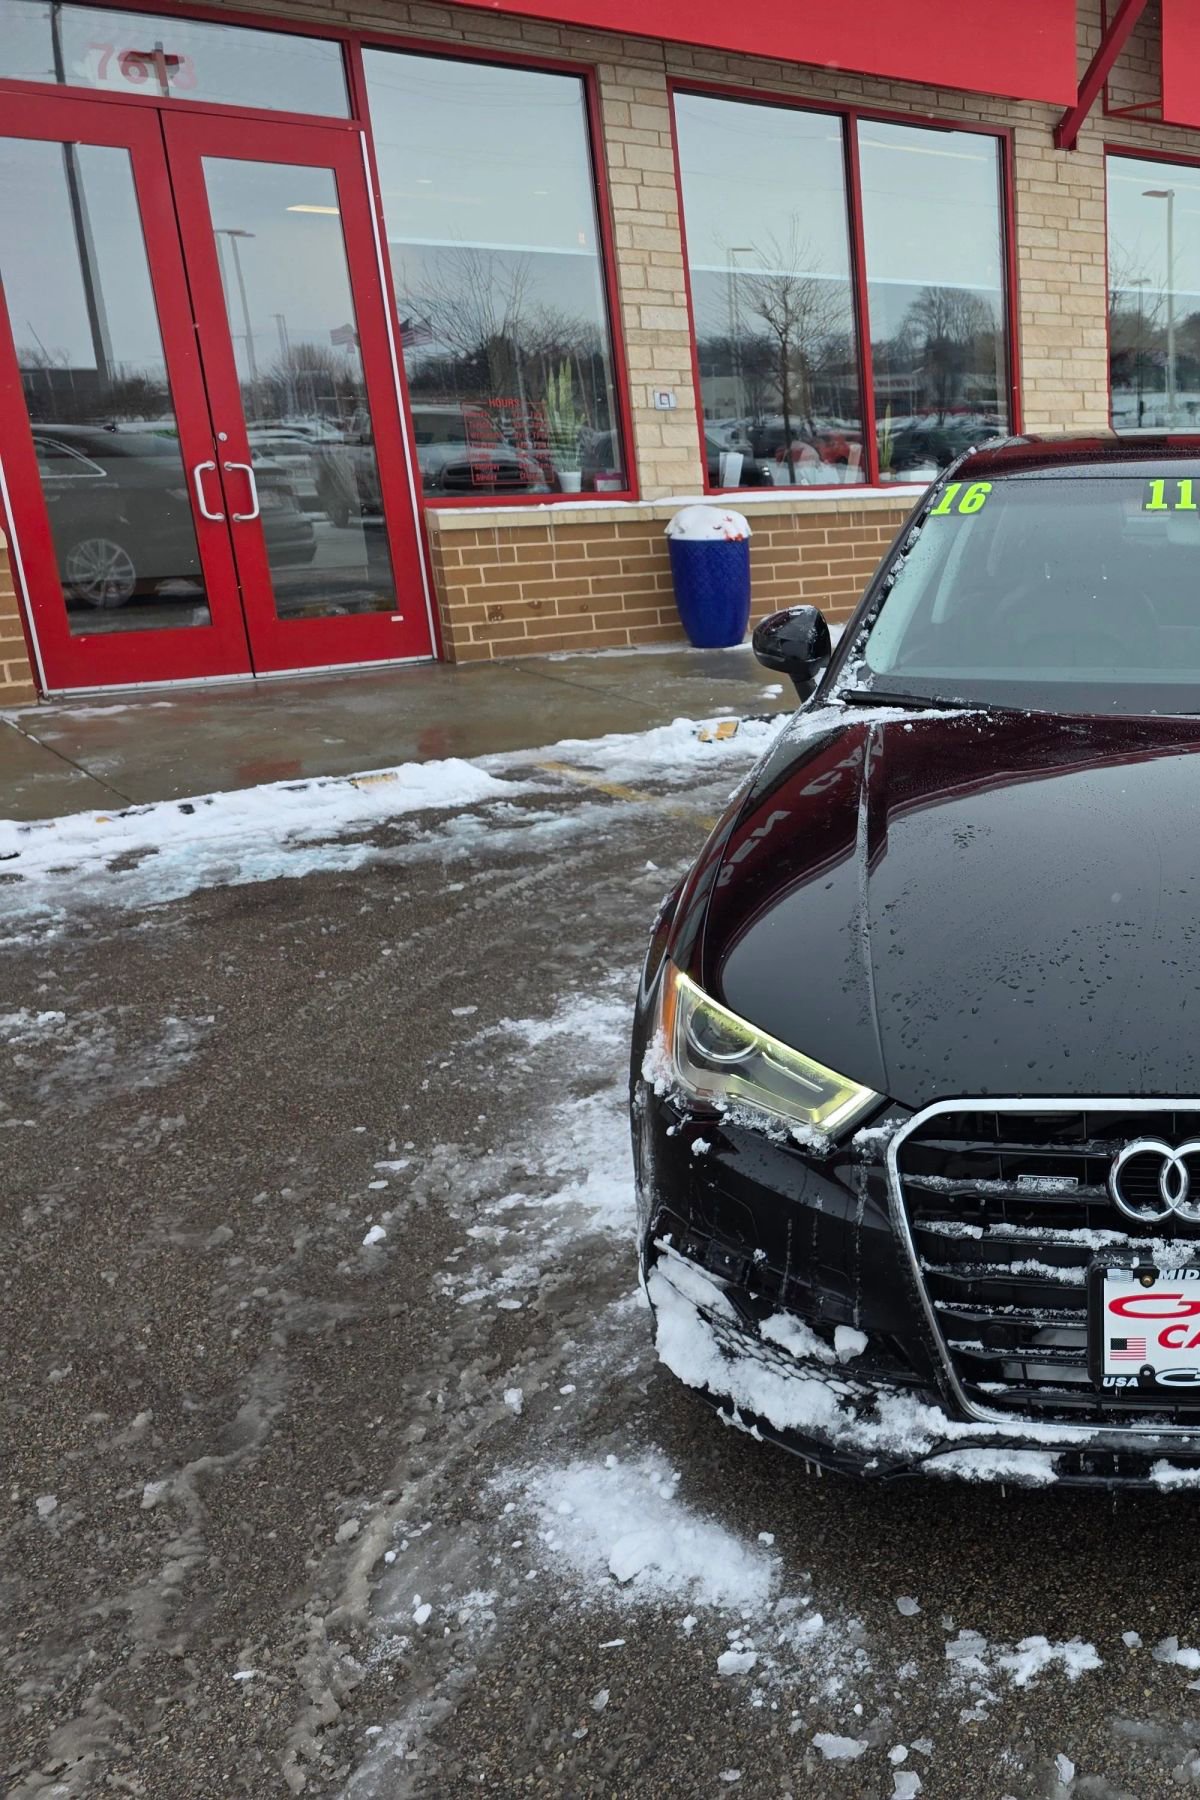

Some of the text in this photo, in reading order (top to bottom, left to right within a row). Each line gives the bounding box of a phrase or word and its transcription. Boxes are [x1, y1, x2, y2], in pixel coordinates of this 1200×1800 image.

[488, 398, 520, 408] HOURS
[929, 482, 992, 516] 16
[1102, 1377, 1140, 1387] USA
